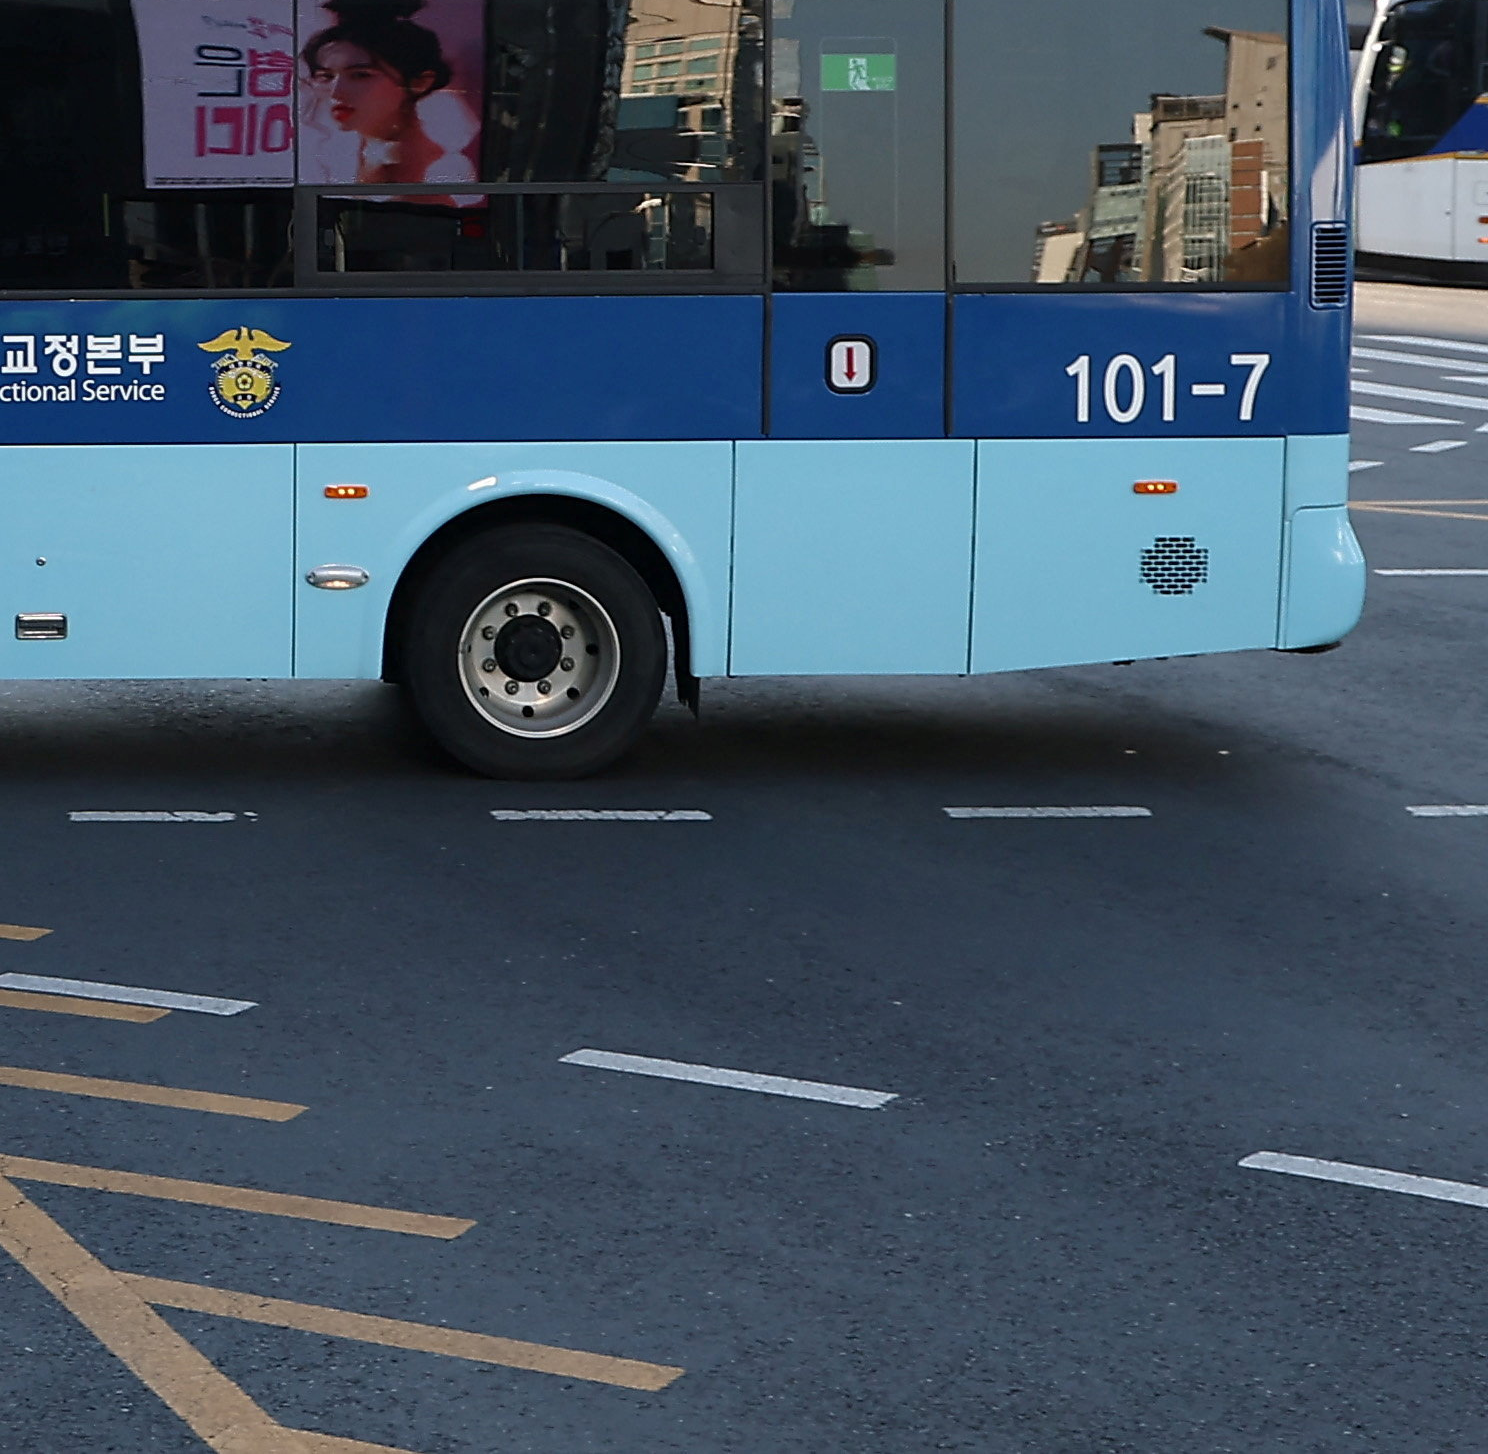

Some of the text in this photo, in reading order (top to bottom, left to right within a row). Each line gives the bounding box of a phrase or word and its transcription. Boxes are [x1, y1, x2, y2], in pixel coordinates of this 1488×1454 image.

[0, 334, 167, 377] 교정본부
[82, 382, 166, 403] Service
[1065, 353, 1271, 423] 101-7
